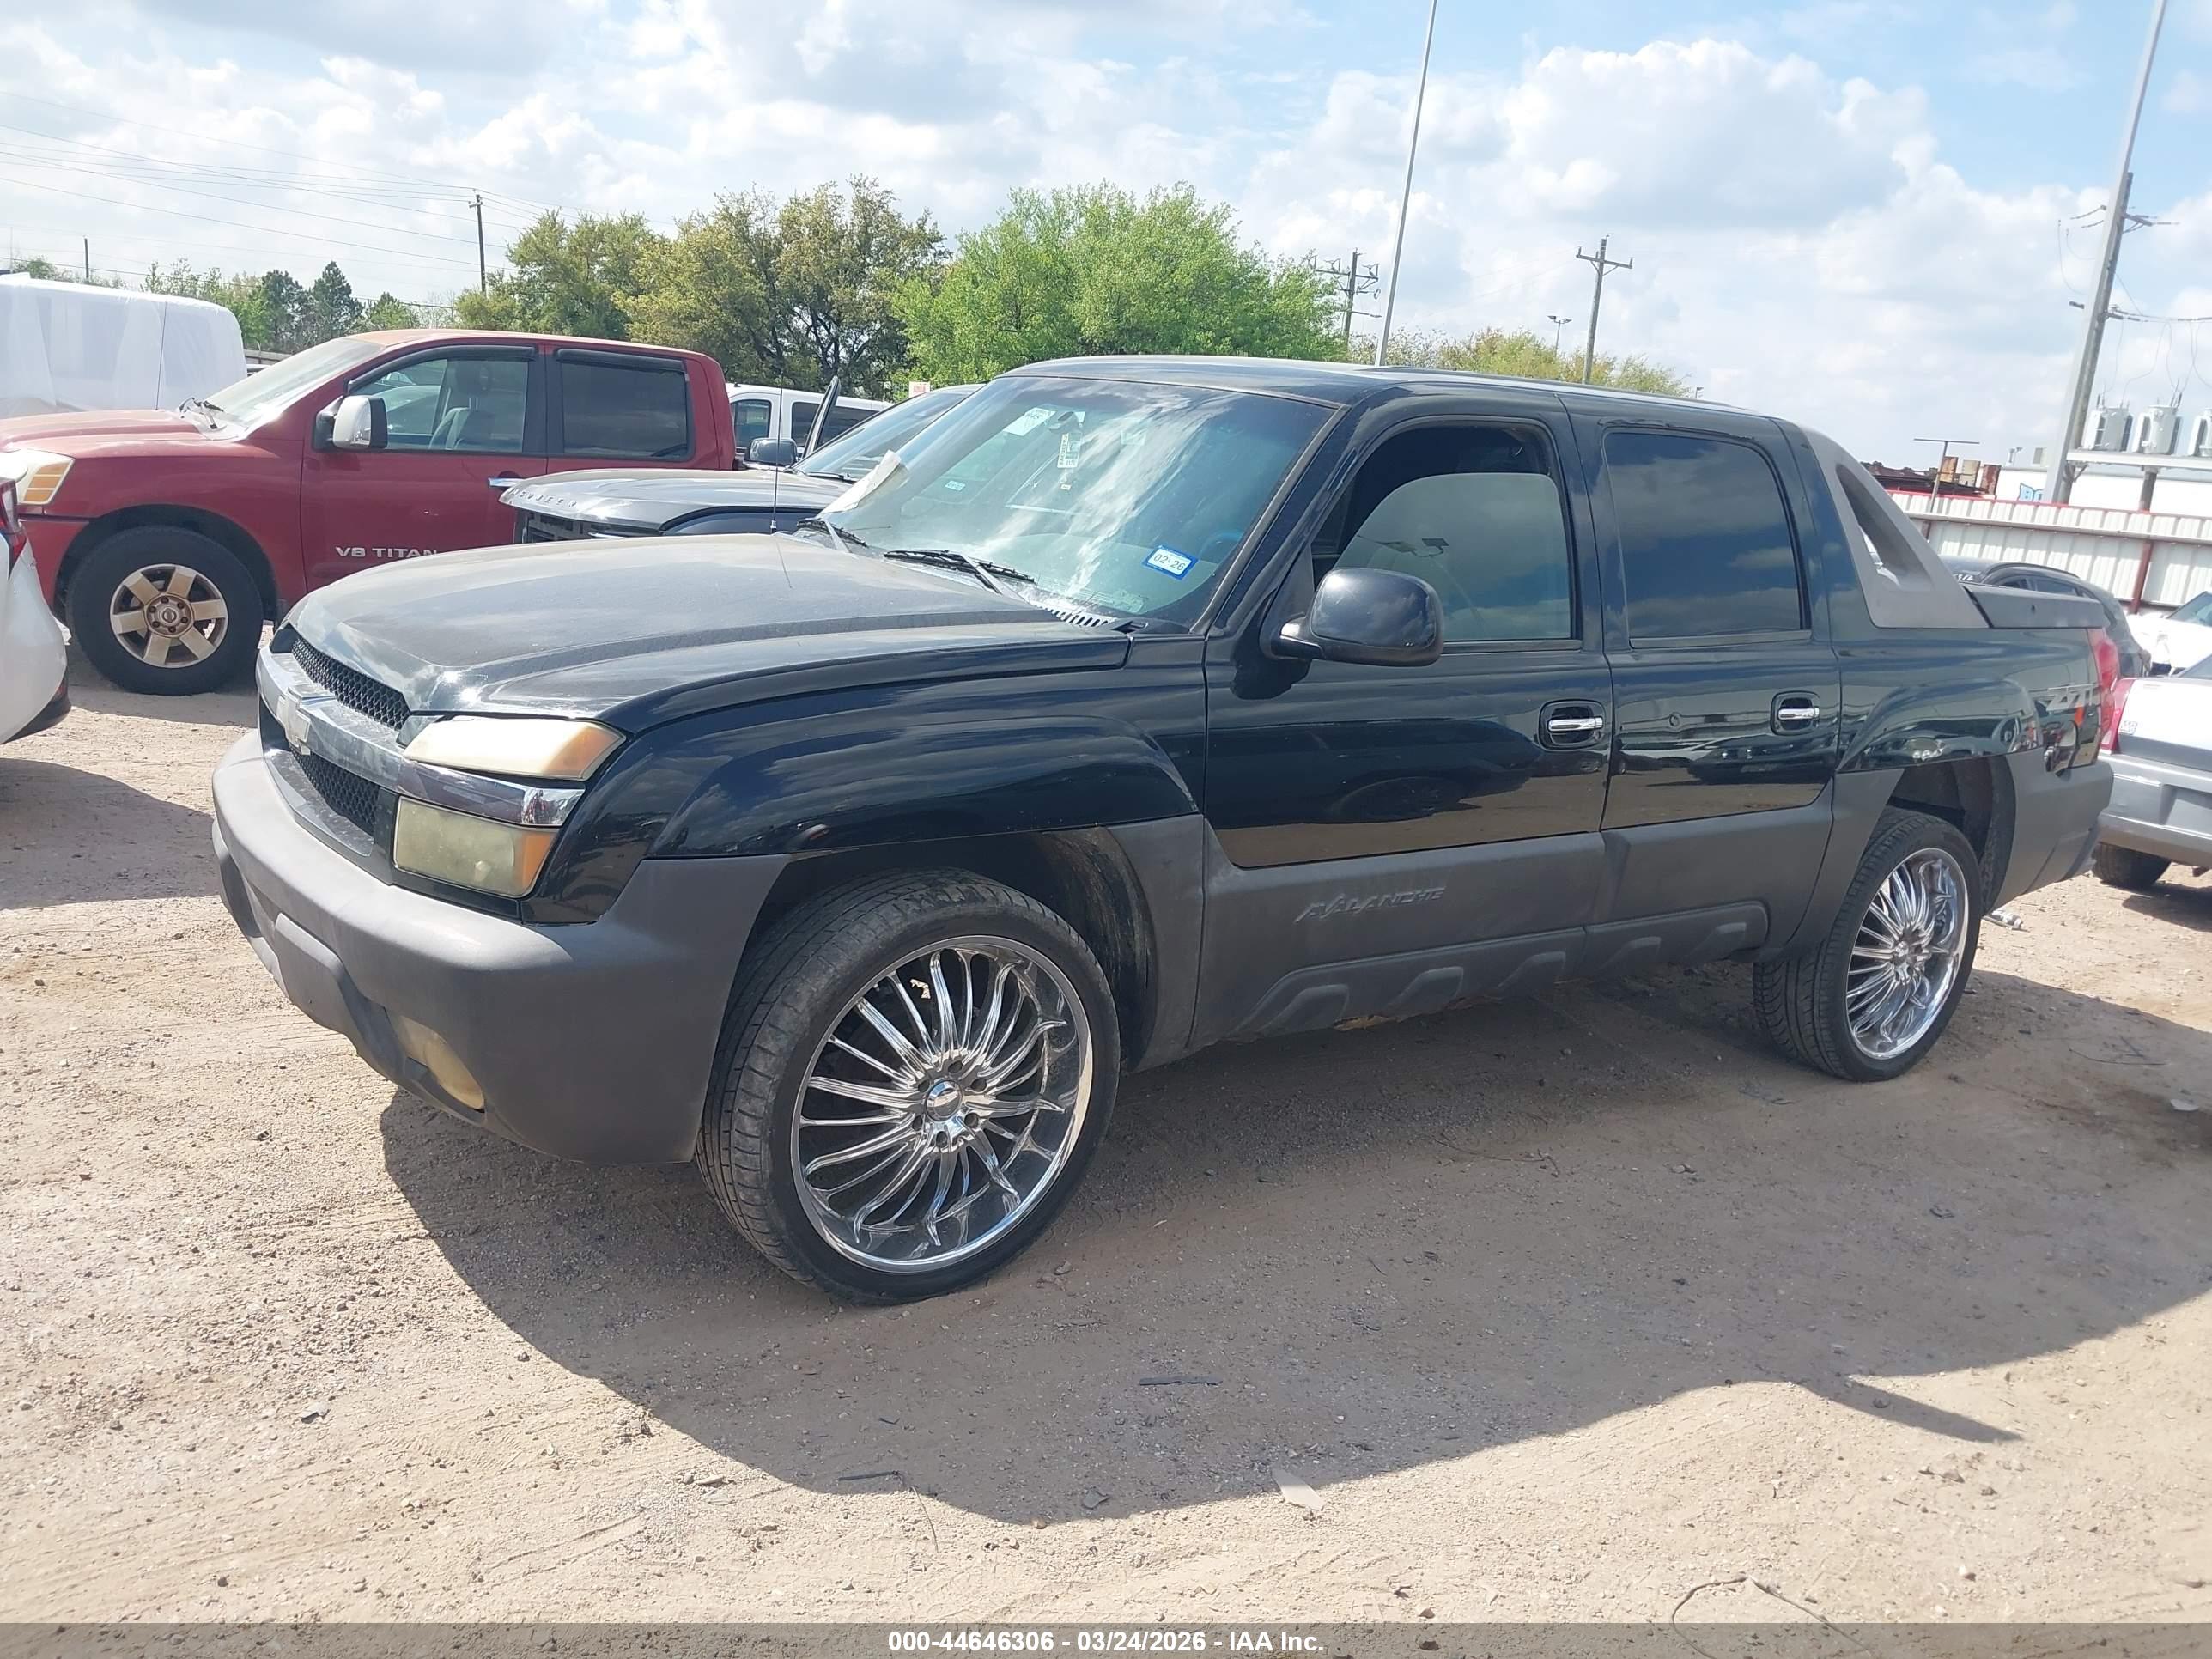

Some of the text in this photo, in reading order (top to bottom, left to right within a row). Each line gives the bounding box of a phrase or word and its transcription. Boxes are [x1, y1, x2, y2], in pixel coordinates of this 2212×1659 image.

[335, 546, 437, 558] V8 TITAN
[1293, 886, 1446, 922] AVALANCHE
